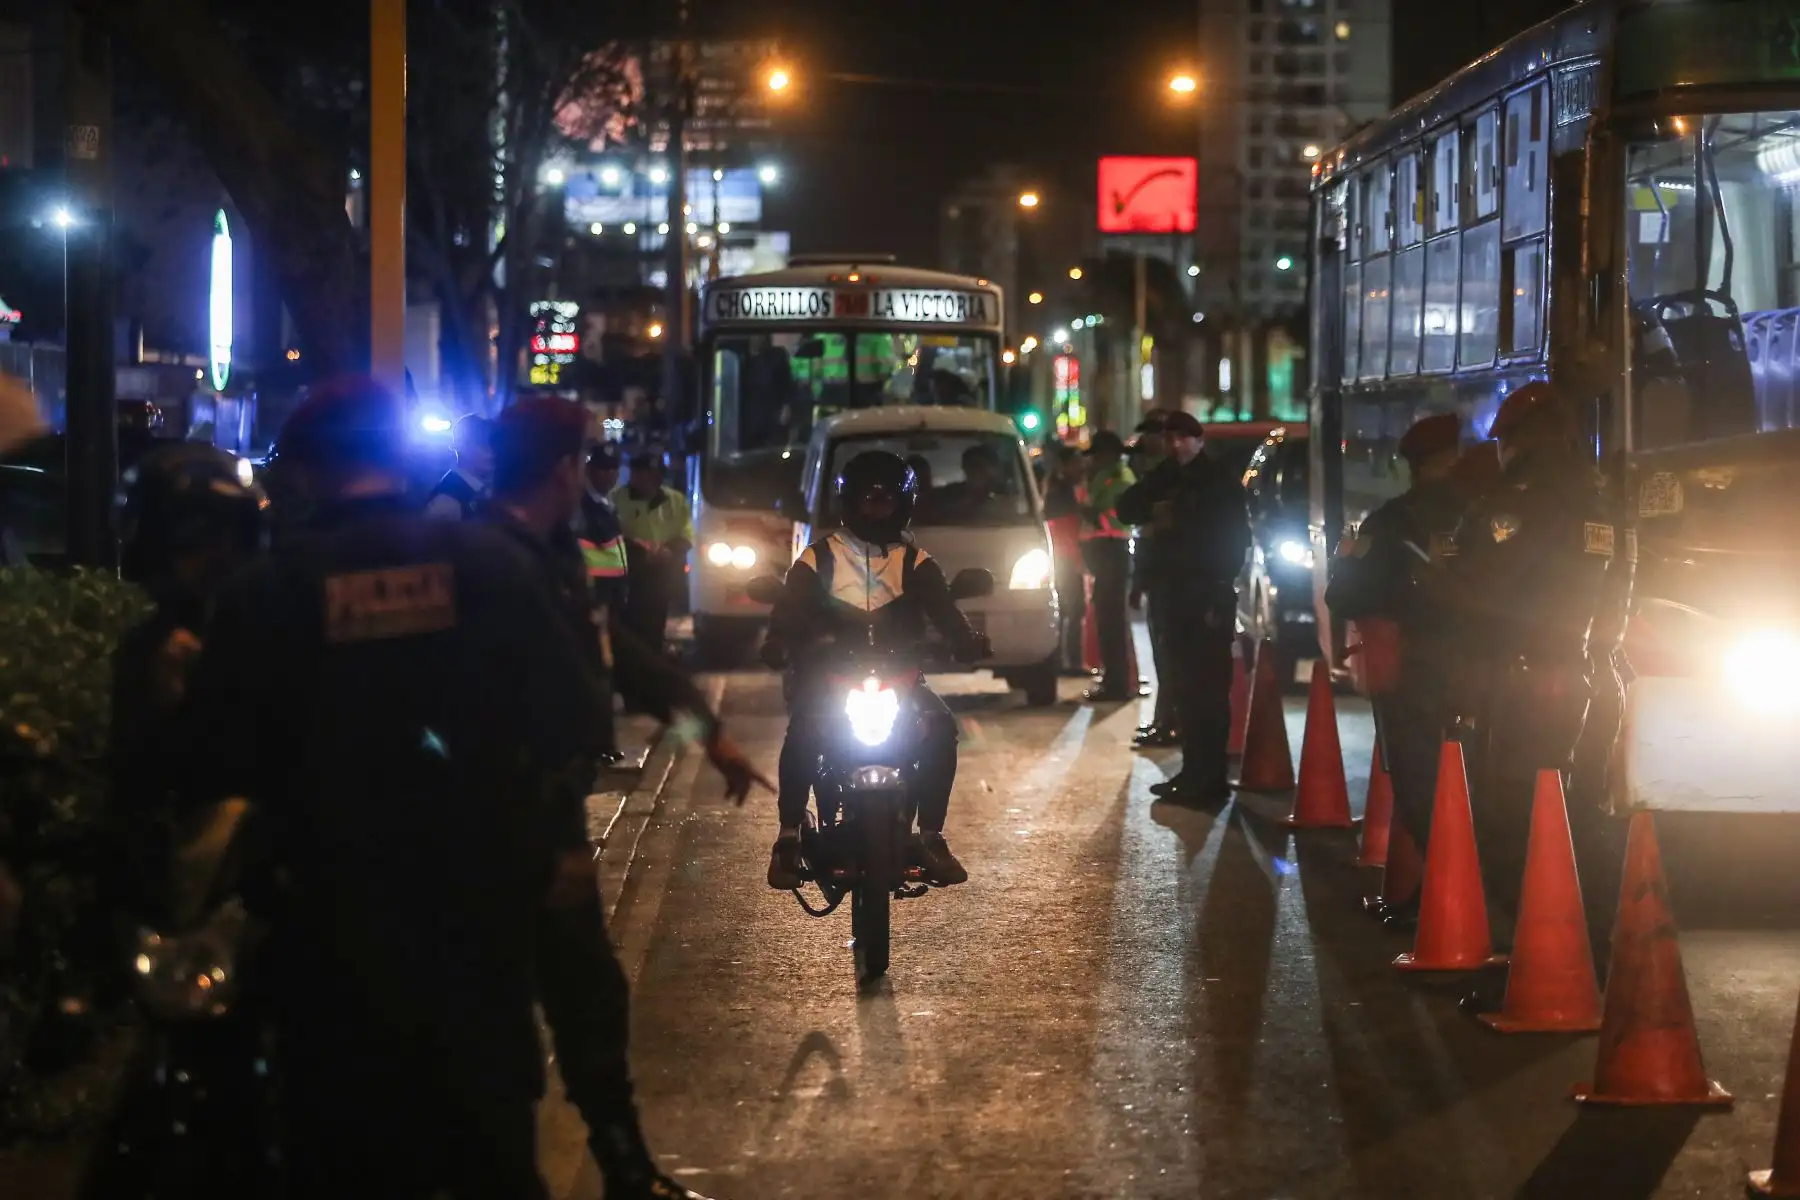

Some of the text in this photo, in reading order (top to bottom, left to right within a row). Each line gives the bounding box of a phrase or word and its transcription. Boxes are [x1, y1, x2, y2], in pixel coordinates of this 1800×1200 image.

[716, 291, 831, 318] CHORRILLOS
[873, 292, 895, 317] LA
[901, 293, 986, 320] VICTORIA
